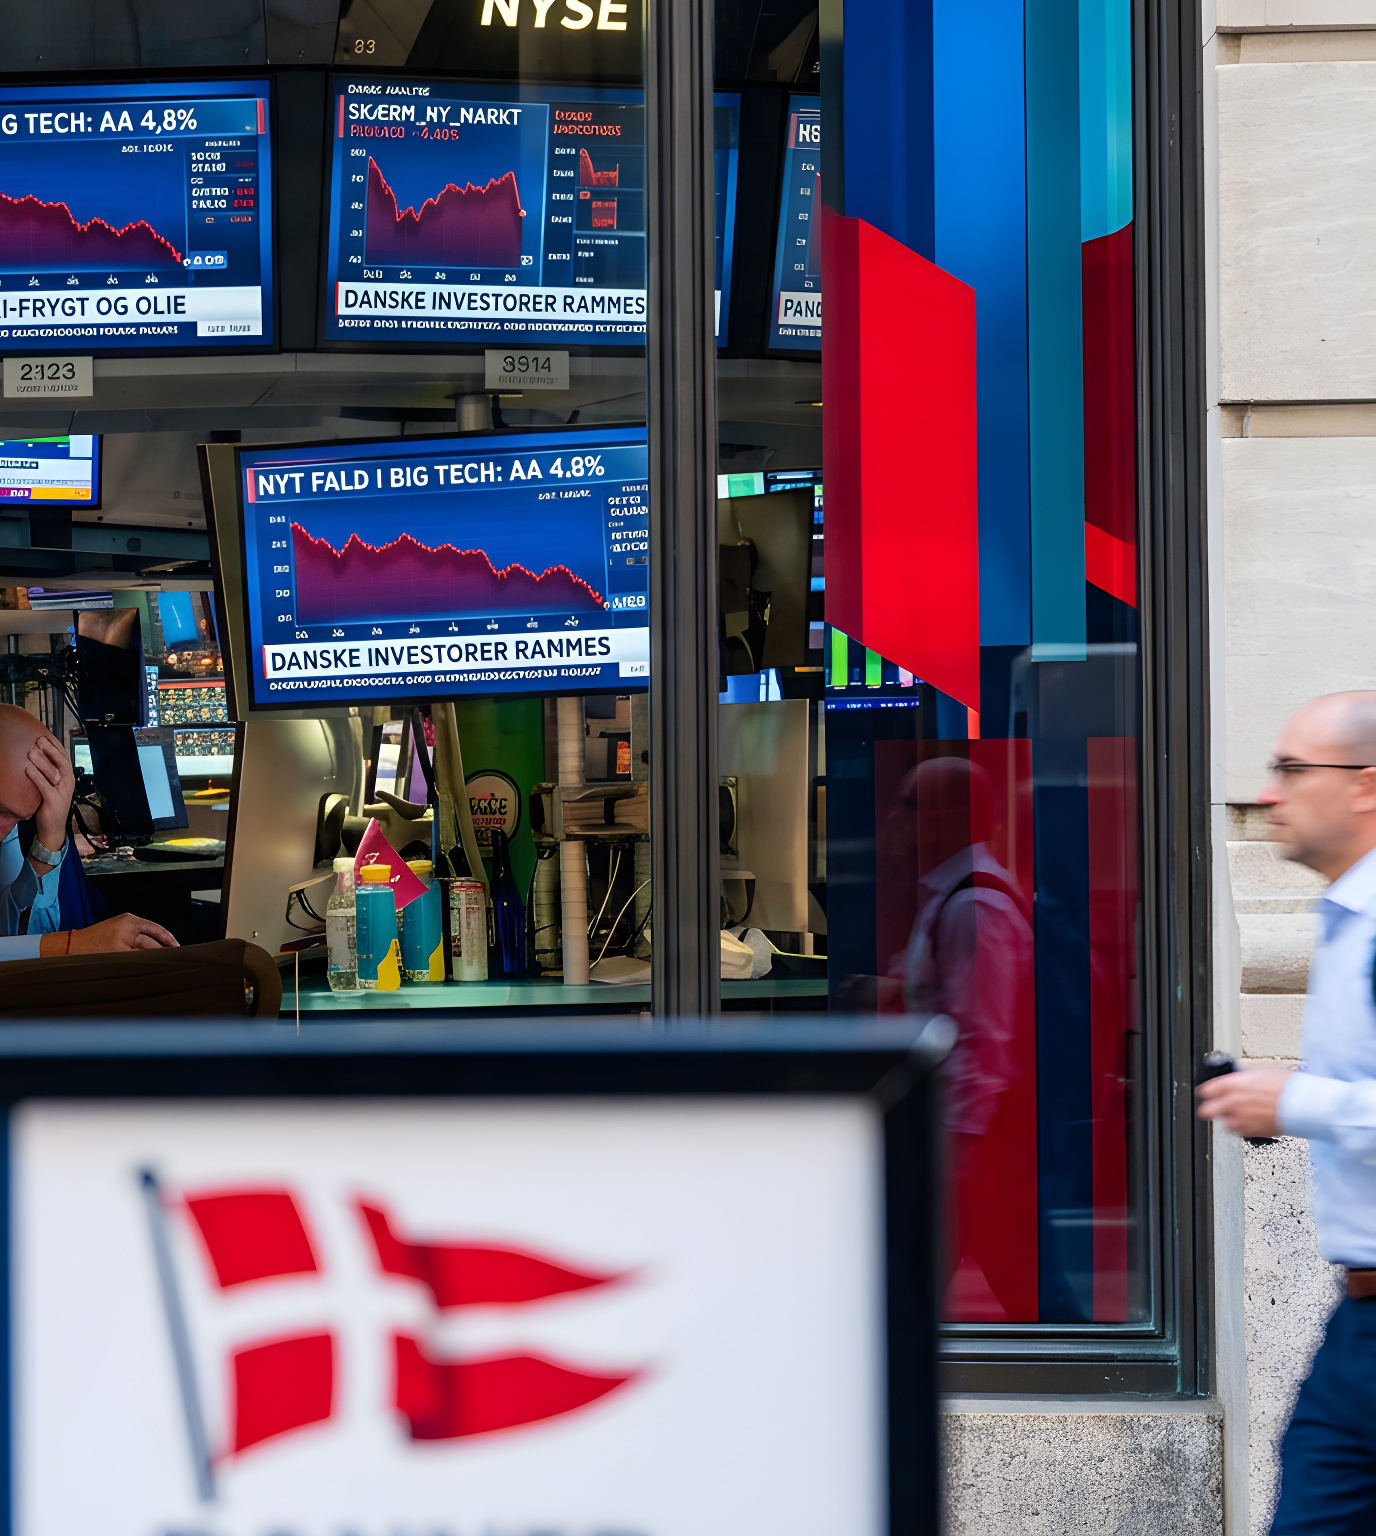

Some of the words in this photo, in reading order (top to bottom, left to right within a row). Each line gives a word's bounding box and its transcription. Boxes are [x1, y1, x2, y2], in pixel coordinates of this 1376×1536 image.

[482, 0, 627, 30] NYSE
[24, 111, 92, 134] TECH:
[99, 110, 134, 132] AA
[140, 108, 198, 134] 4,8%
[96, 296, 129, 316] OG
[135, 295, 186, 316] OLIE
[344, 289, 426, 310] DANSKE
[431, 291, 557, 313] INVESTORER
[563, 294, 645, 315] RAMMES
[258, 472, 305, 496] NYT
[311, 469, 369, 493] FALD
[376, 468, 382, 489] I
[390, 466, 429, 488] BIG
[433, 461, 503, 485] TECH:
[509, 459, 543, 481] AA
[271, 649, 361, 672] DANSKE
[367, 642, 508, 667] INVESTORER
[515, 636, 611, 660] RAMMES
